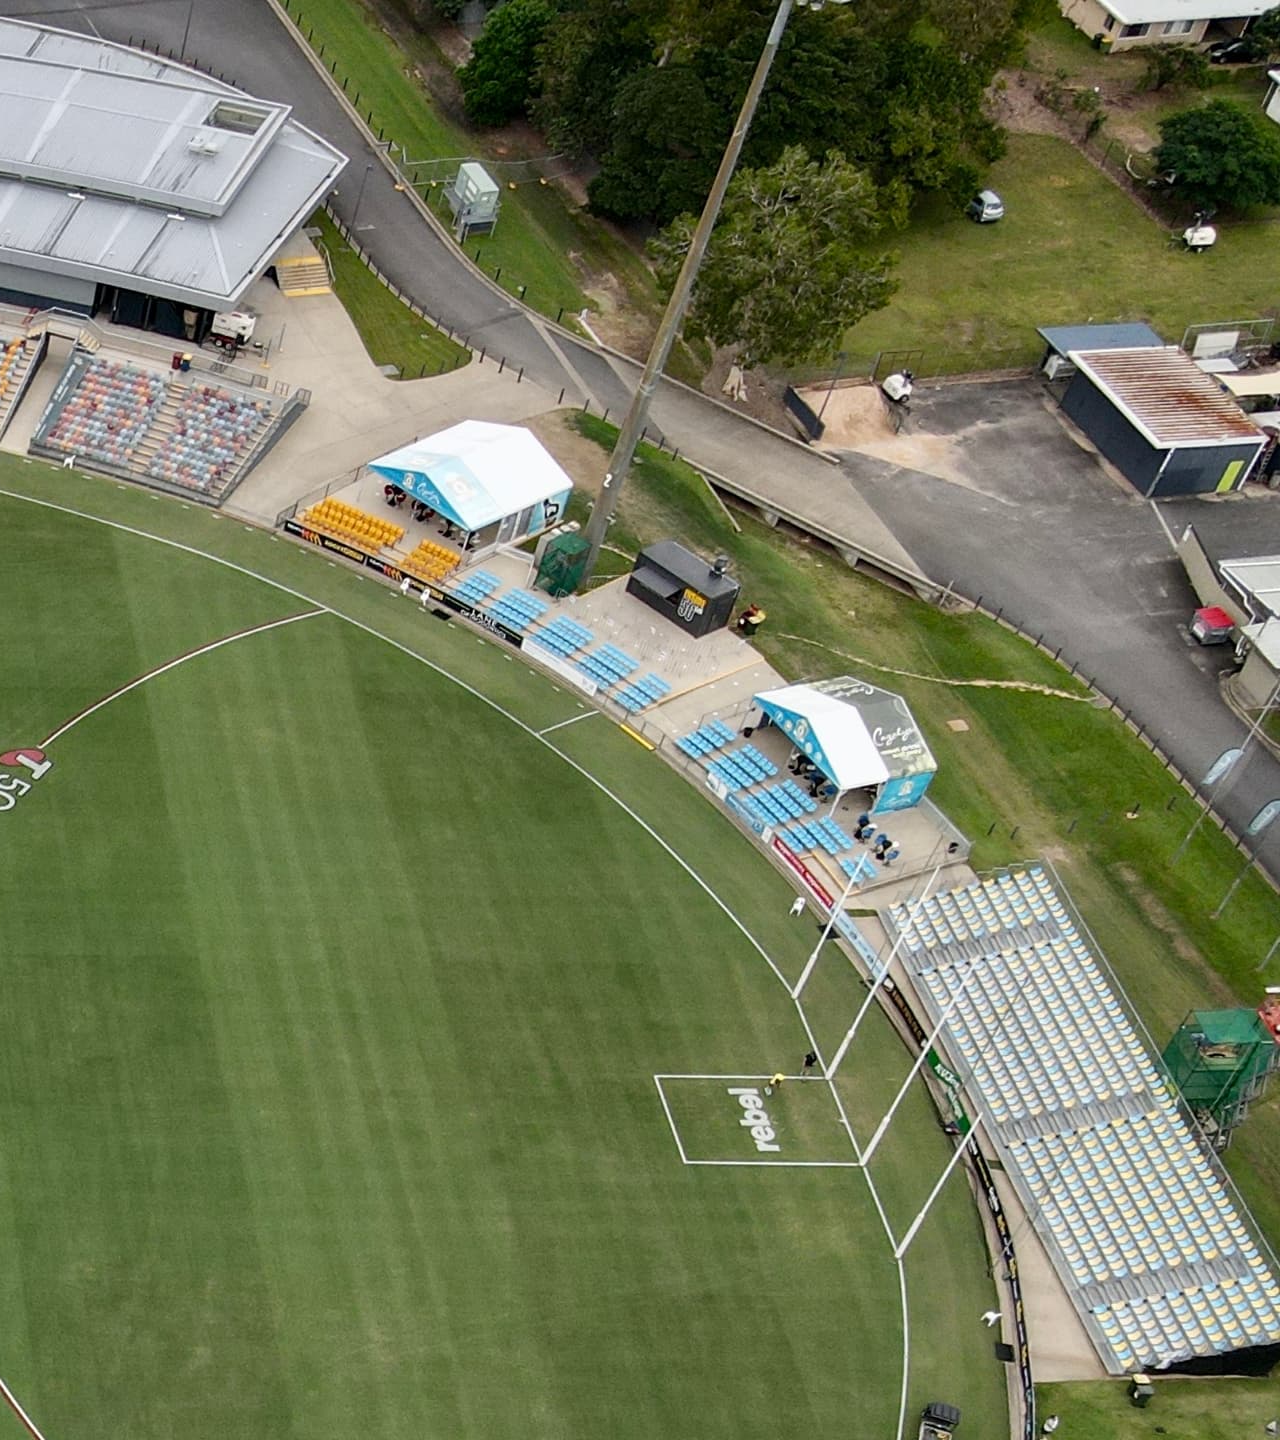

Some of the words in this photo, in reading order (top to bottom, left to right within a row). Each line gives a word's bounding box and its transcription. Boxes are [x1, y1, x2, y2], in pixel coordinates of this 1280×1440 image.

[603, 473, 613, 488] 2
[471, 608, 498, 628] LANE
[728, 1088, 781, 1152] rebel
